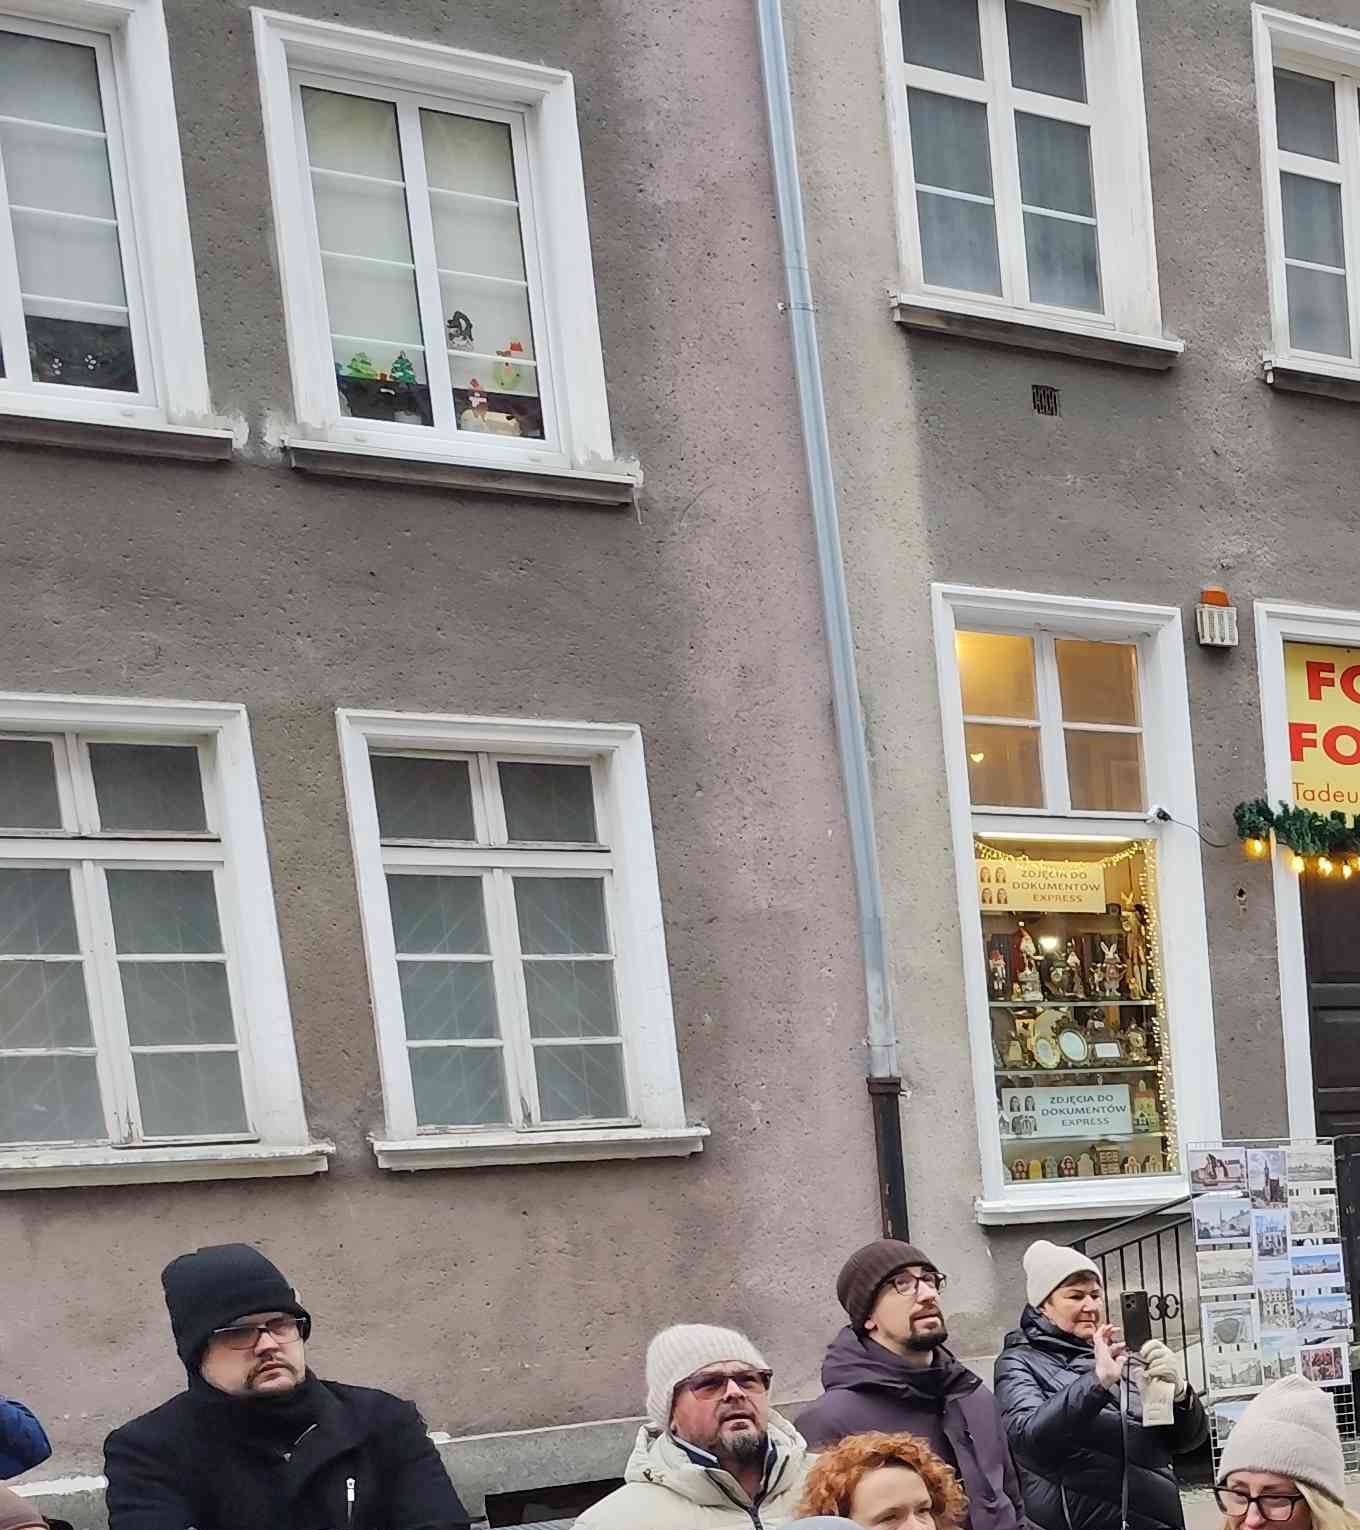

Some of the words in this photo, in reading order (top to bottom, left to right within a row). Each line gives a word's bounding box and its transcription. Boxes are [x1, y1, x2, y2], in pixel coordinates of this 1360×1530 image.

[1021, 870, 1067, 880] ZDJĘCIA
[1070, 871, 1088, 880] DO
[1012, 881, 1101, 891] DOKUMENTÓW
[1032, 893, 1083, 903] EXPRESS
[1048, 1094, 1095, 1105] ZDJĘCIA
[1097, 1093, 1114, 1102] DO
[1041, 1104, 1128, 1117] DOKUMENTÓW
[1061, 1117, 1111, 1127] EXPRESS
